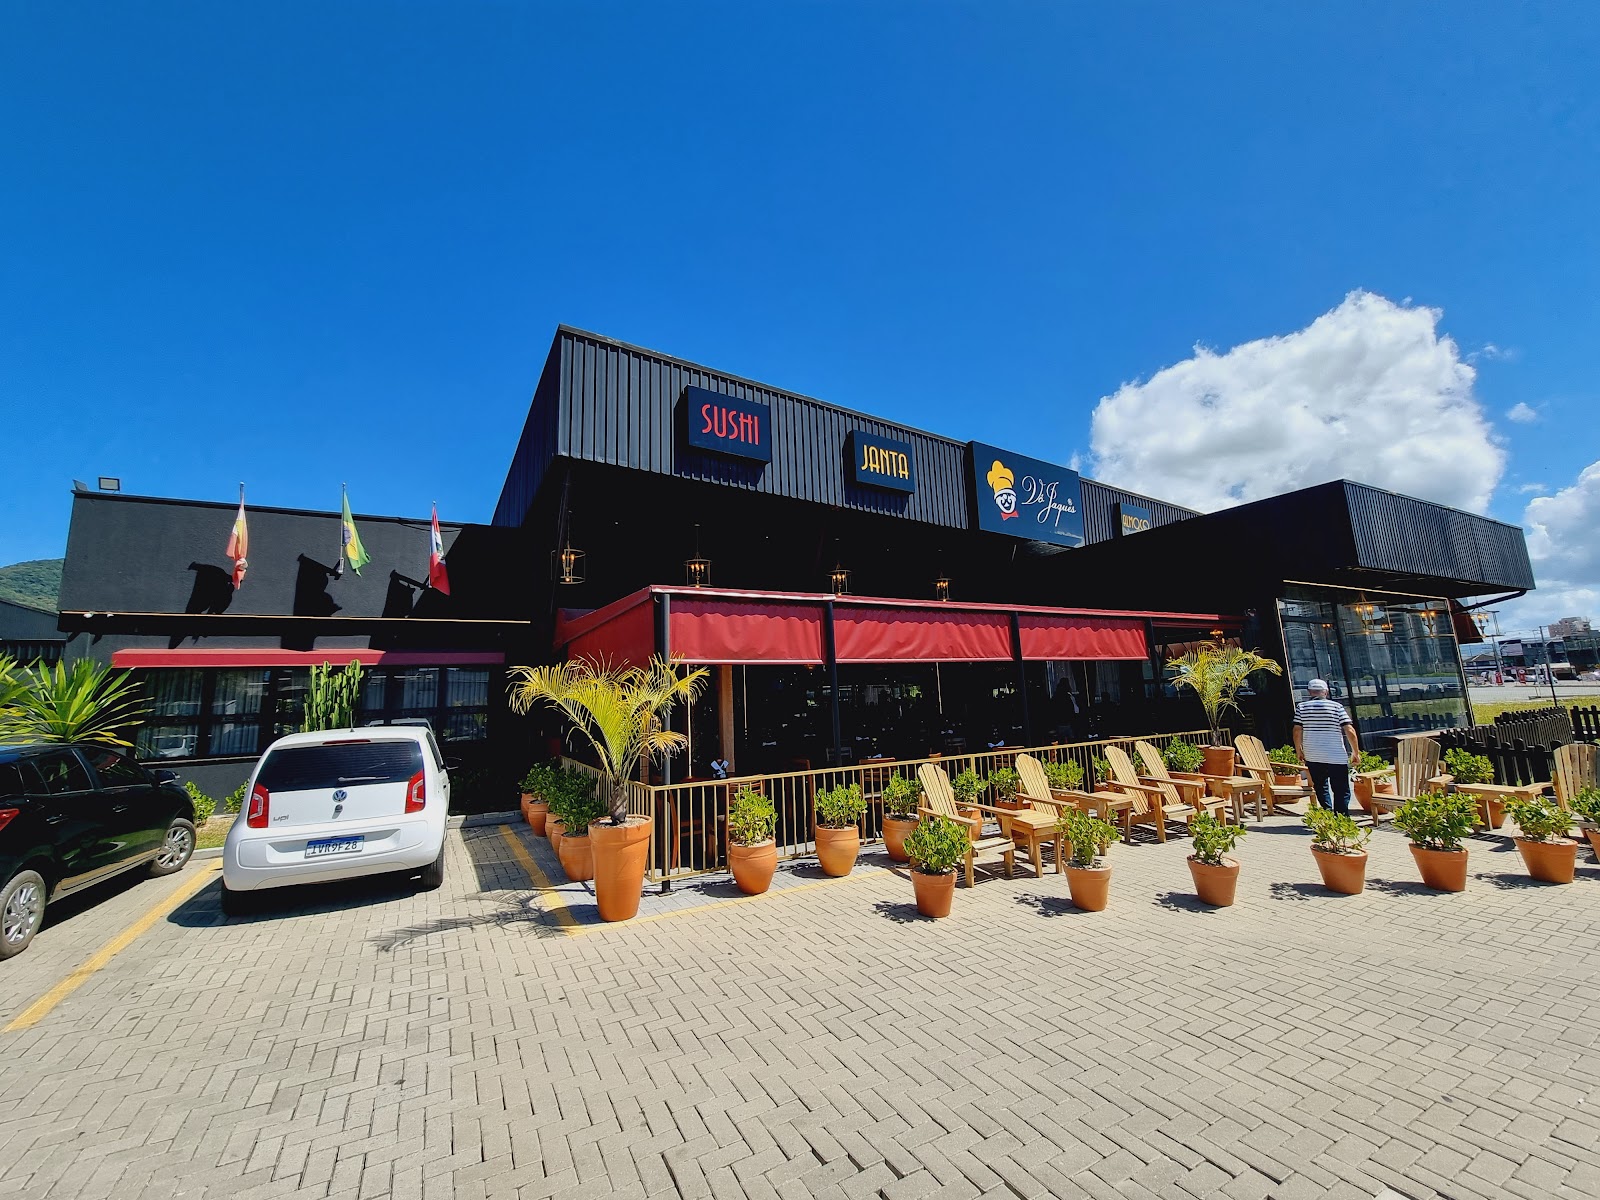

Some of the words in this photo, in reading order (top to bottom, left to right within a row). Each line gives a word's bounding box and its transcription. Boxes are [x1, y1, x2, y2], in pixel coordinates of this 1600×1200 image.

[702, 404, 759, 445] SUSHI
[861, 445, 909, 480] JANTA
[311, 841, 358, 854] IVR9F28
